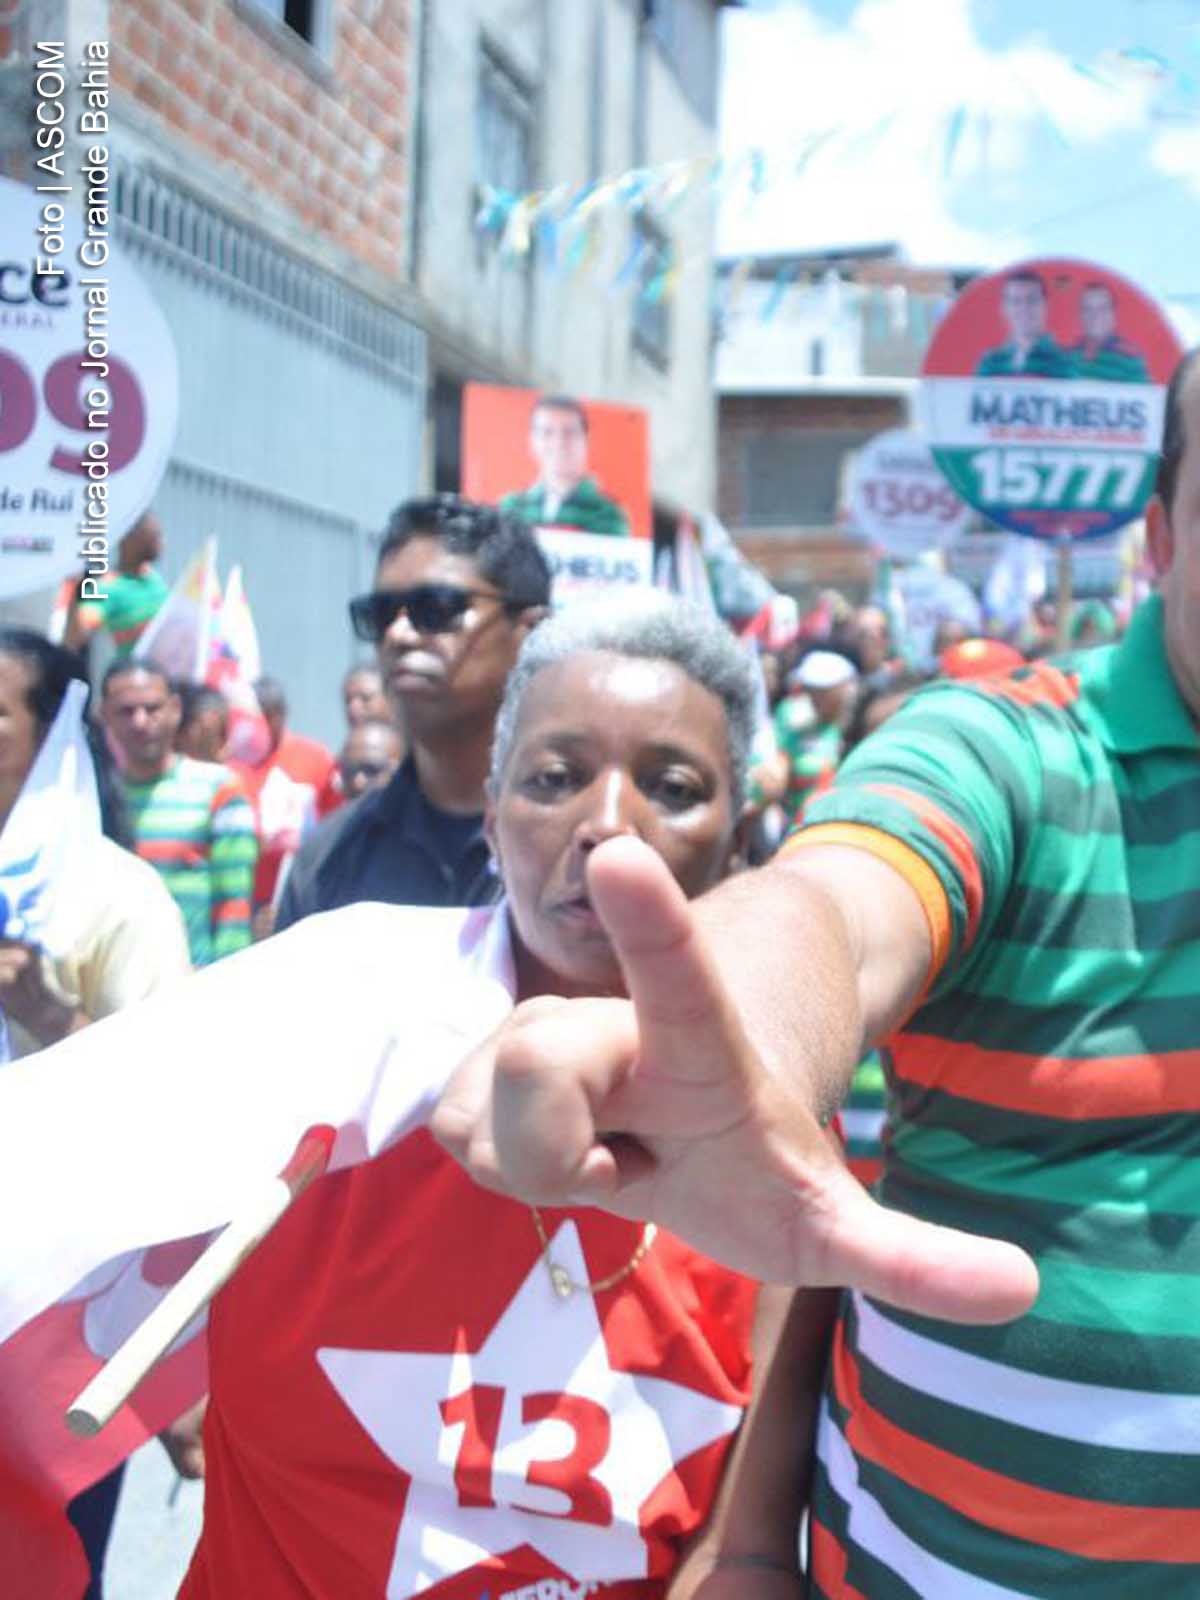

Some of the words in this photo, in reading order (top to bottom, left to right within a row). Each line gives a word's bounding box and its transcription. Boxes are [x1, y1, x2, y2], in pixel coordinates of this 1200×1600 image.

[970, 391, 1149, 429] MATHEUS
[971, 450, 1149, 509] 15777
[437, 1382, 614, 1528] 13
